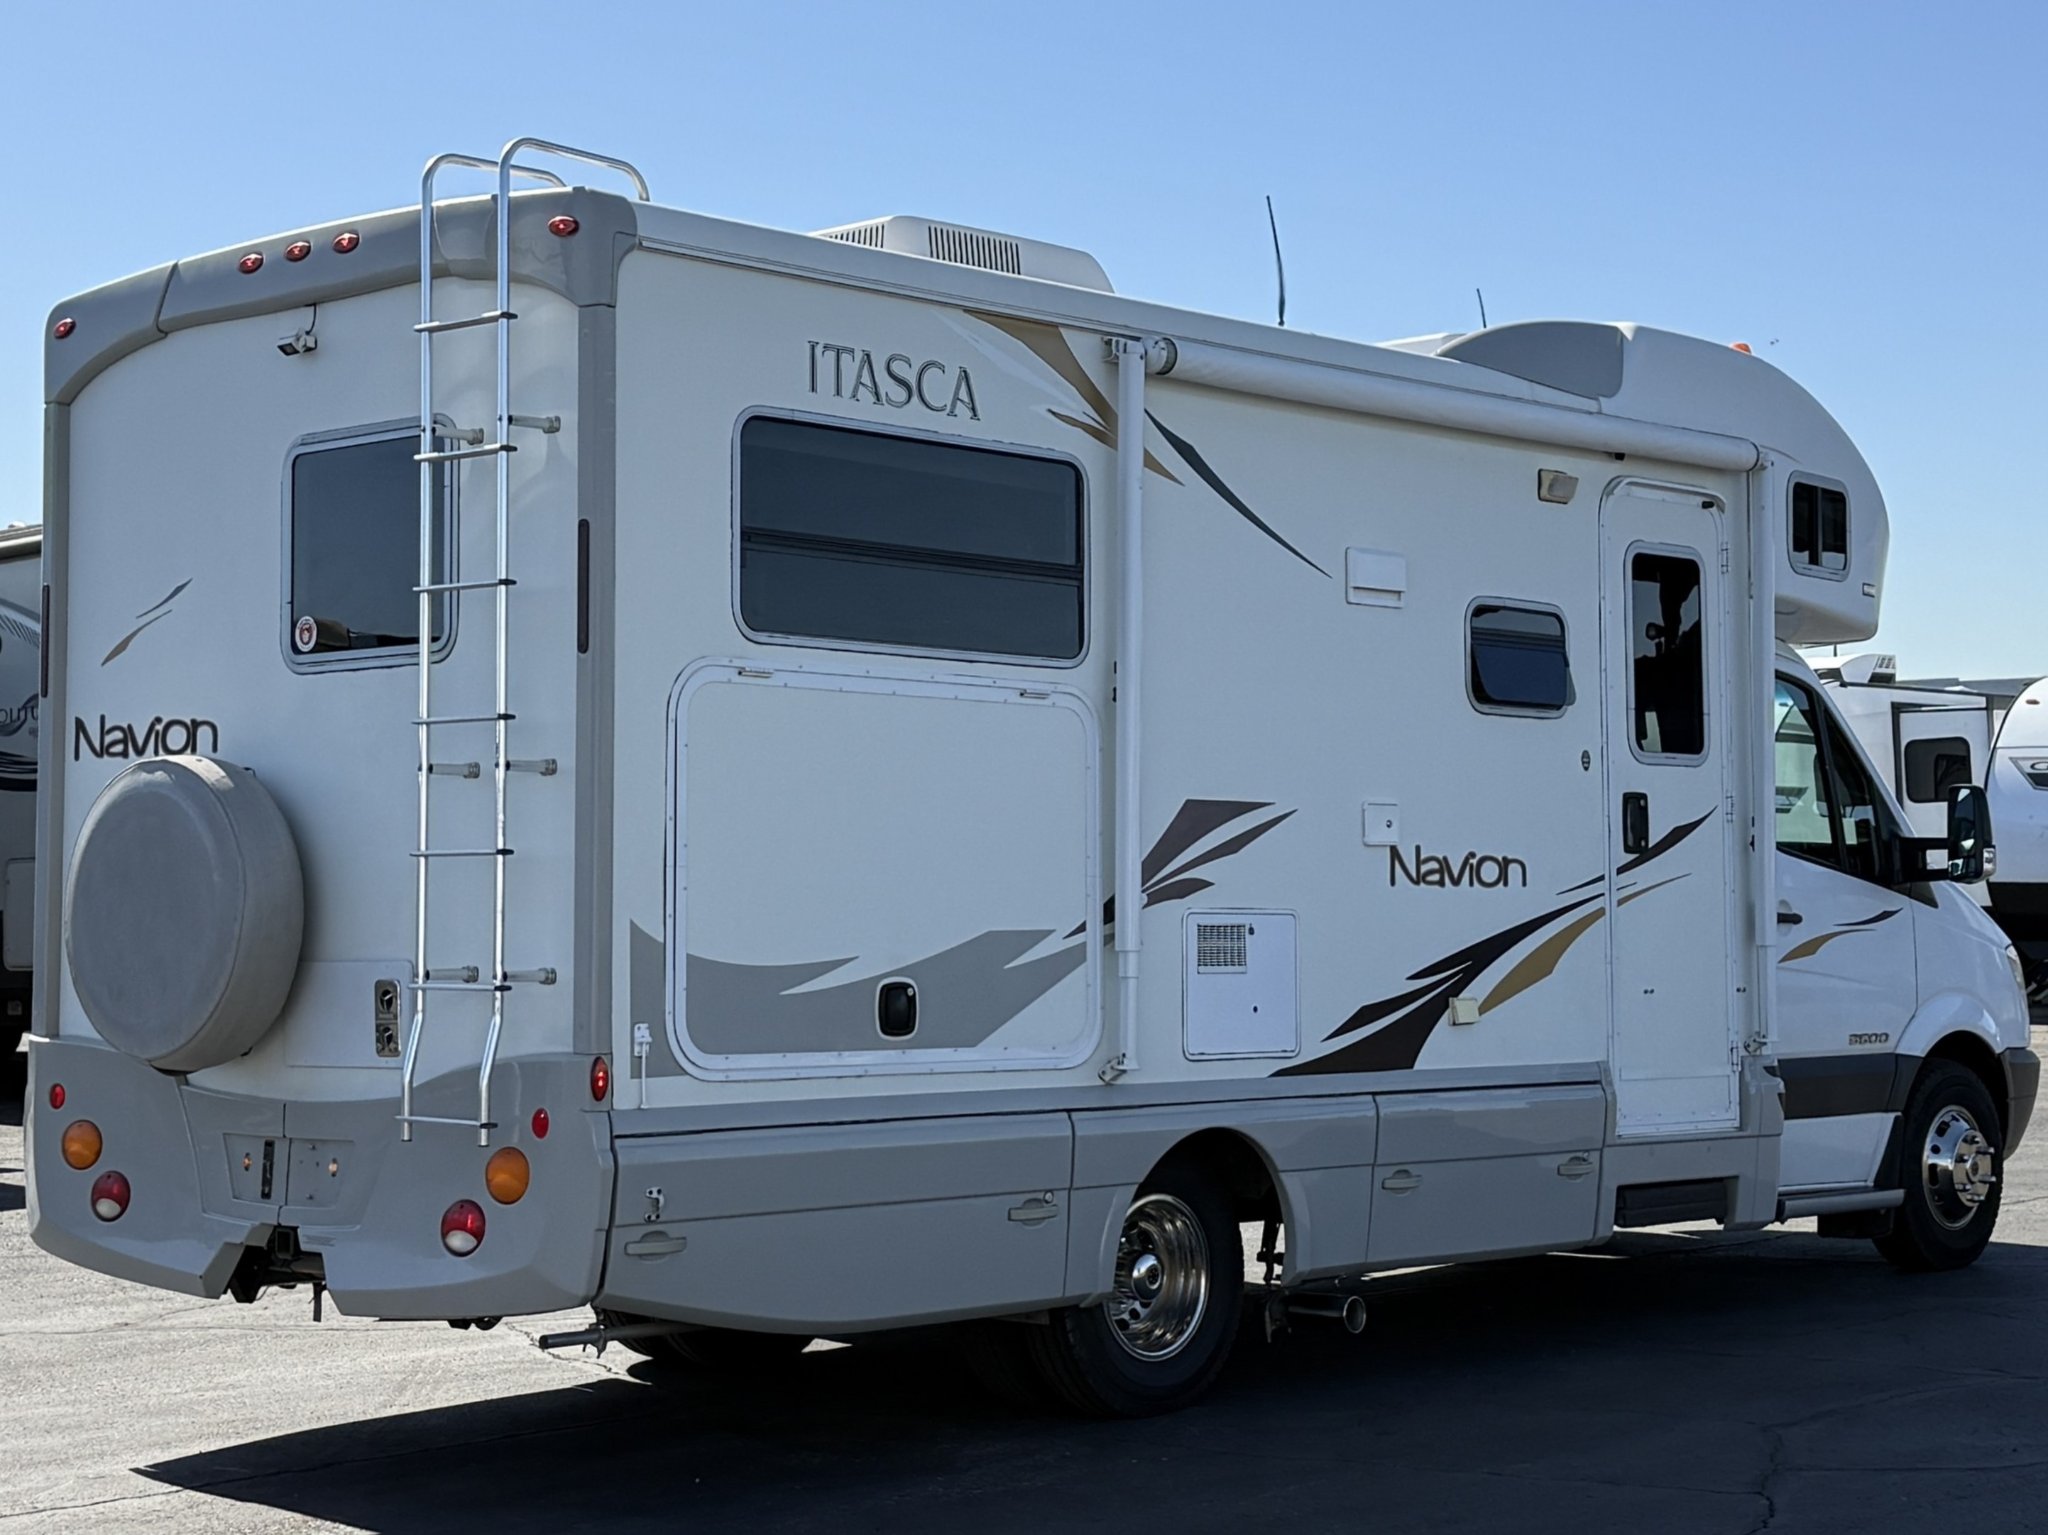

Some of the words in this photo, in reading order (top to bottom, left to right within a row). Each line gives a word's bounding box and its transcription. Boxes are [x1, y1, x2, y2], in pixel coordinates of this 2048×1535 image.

[807, 340, 981, 421] ITASCA
[74, 714, 218, 762] Navion
[1389, 844, 1528, 888] Navion
